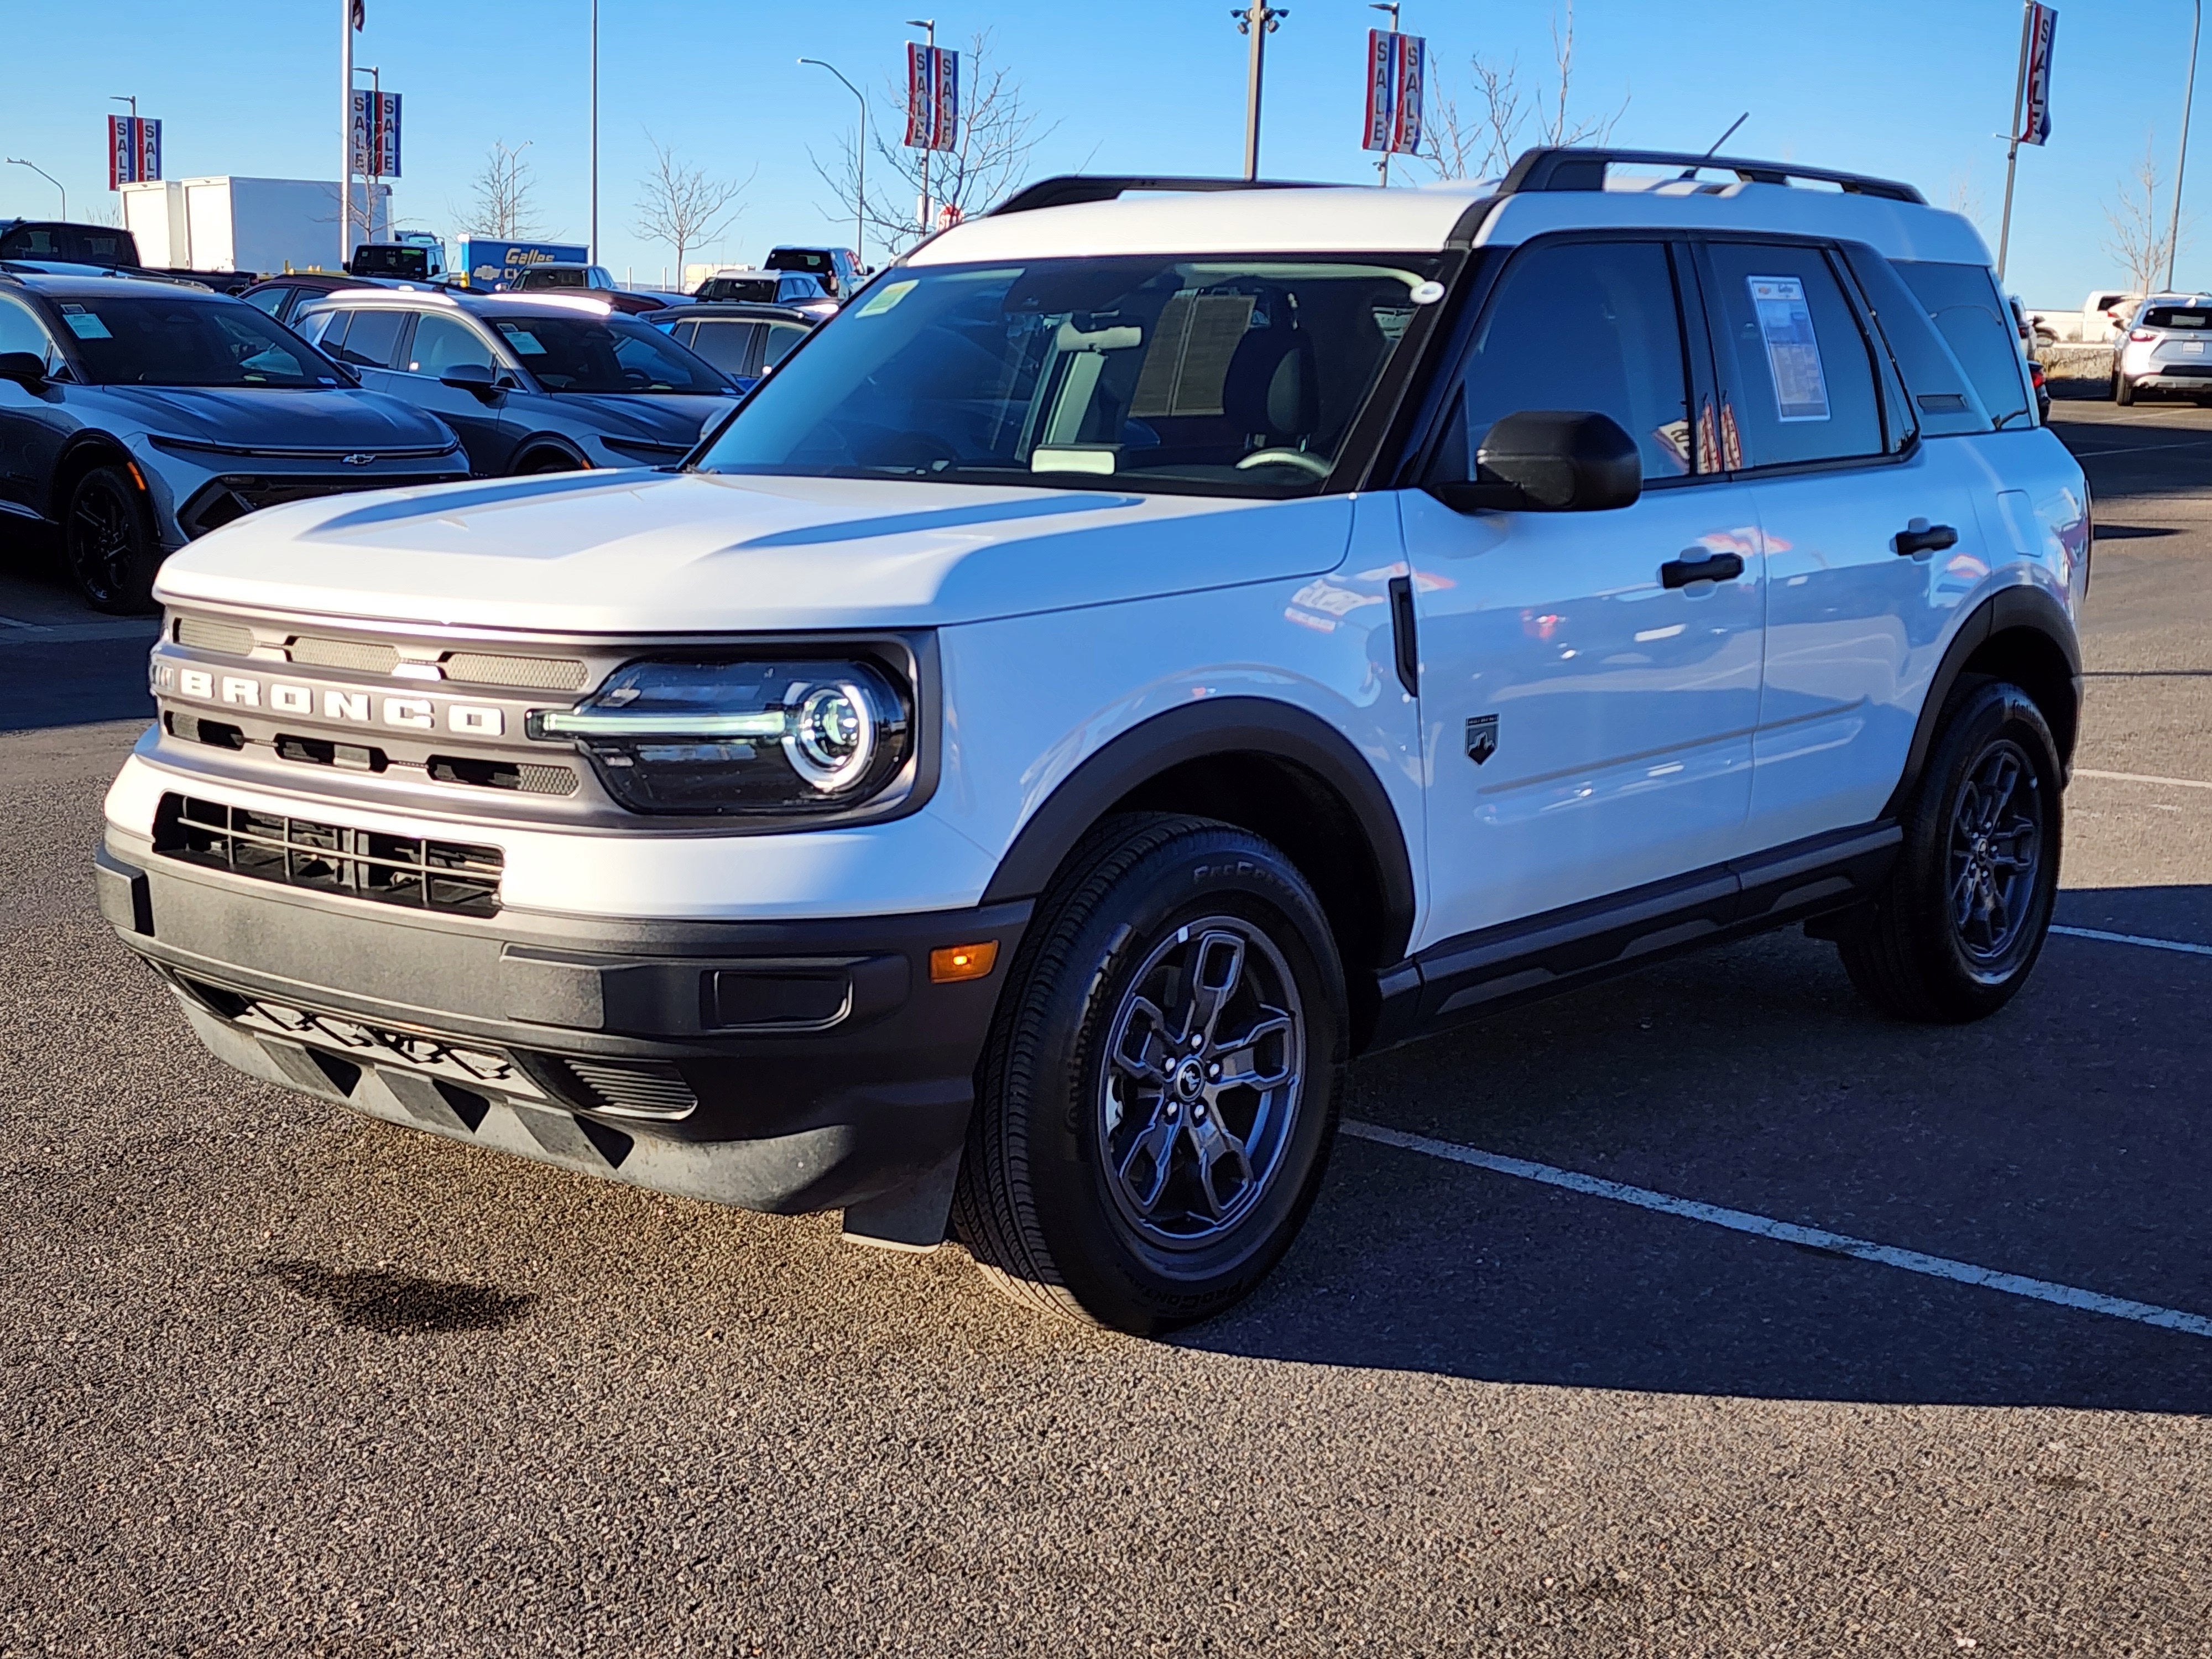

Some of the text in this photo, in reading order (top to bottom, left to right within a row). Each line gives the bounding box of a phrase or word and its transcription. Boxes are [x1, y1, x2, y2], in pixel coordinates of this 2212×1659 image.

[914, 53, 926, 139] SALE
[942, 58, 953, 144] SALE
[1374, 40, 1387, 141] SALE
[1403, 45, 1418, 144] SALE
[354, 96, 365, 168] SALE
[383, 99, 394, 170] SALE
[505, 248, 555, 265] Galles
[180, 668, 505, 737] BRONCO
